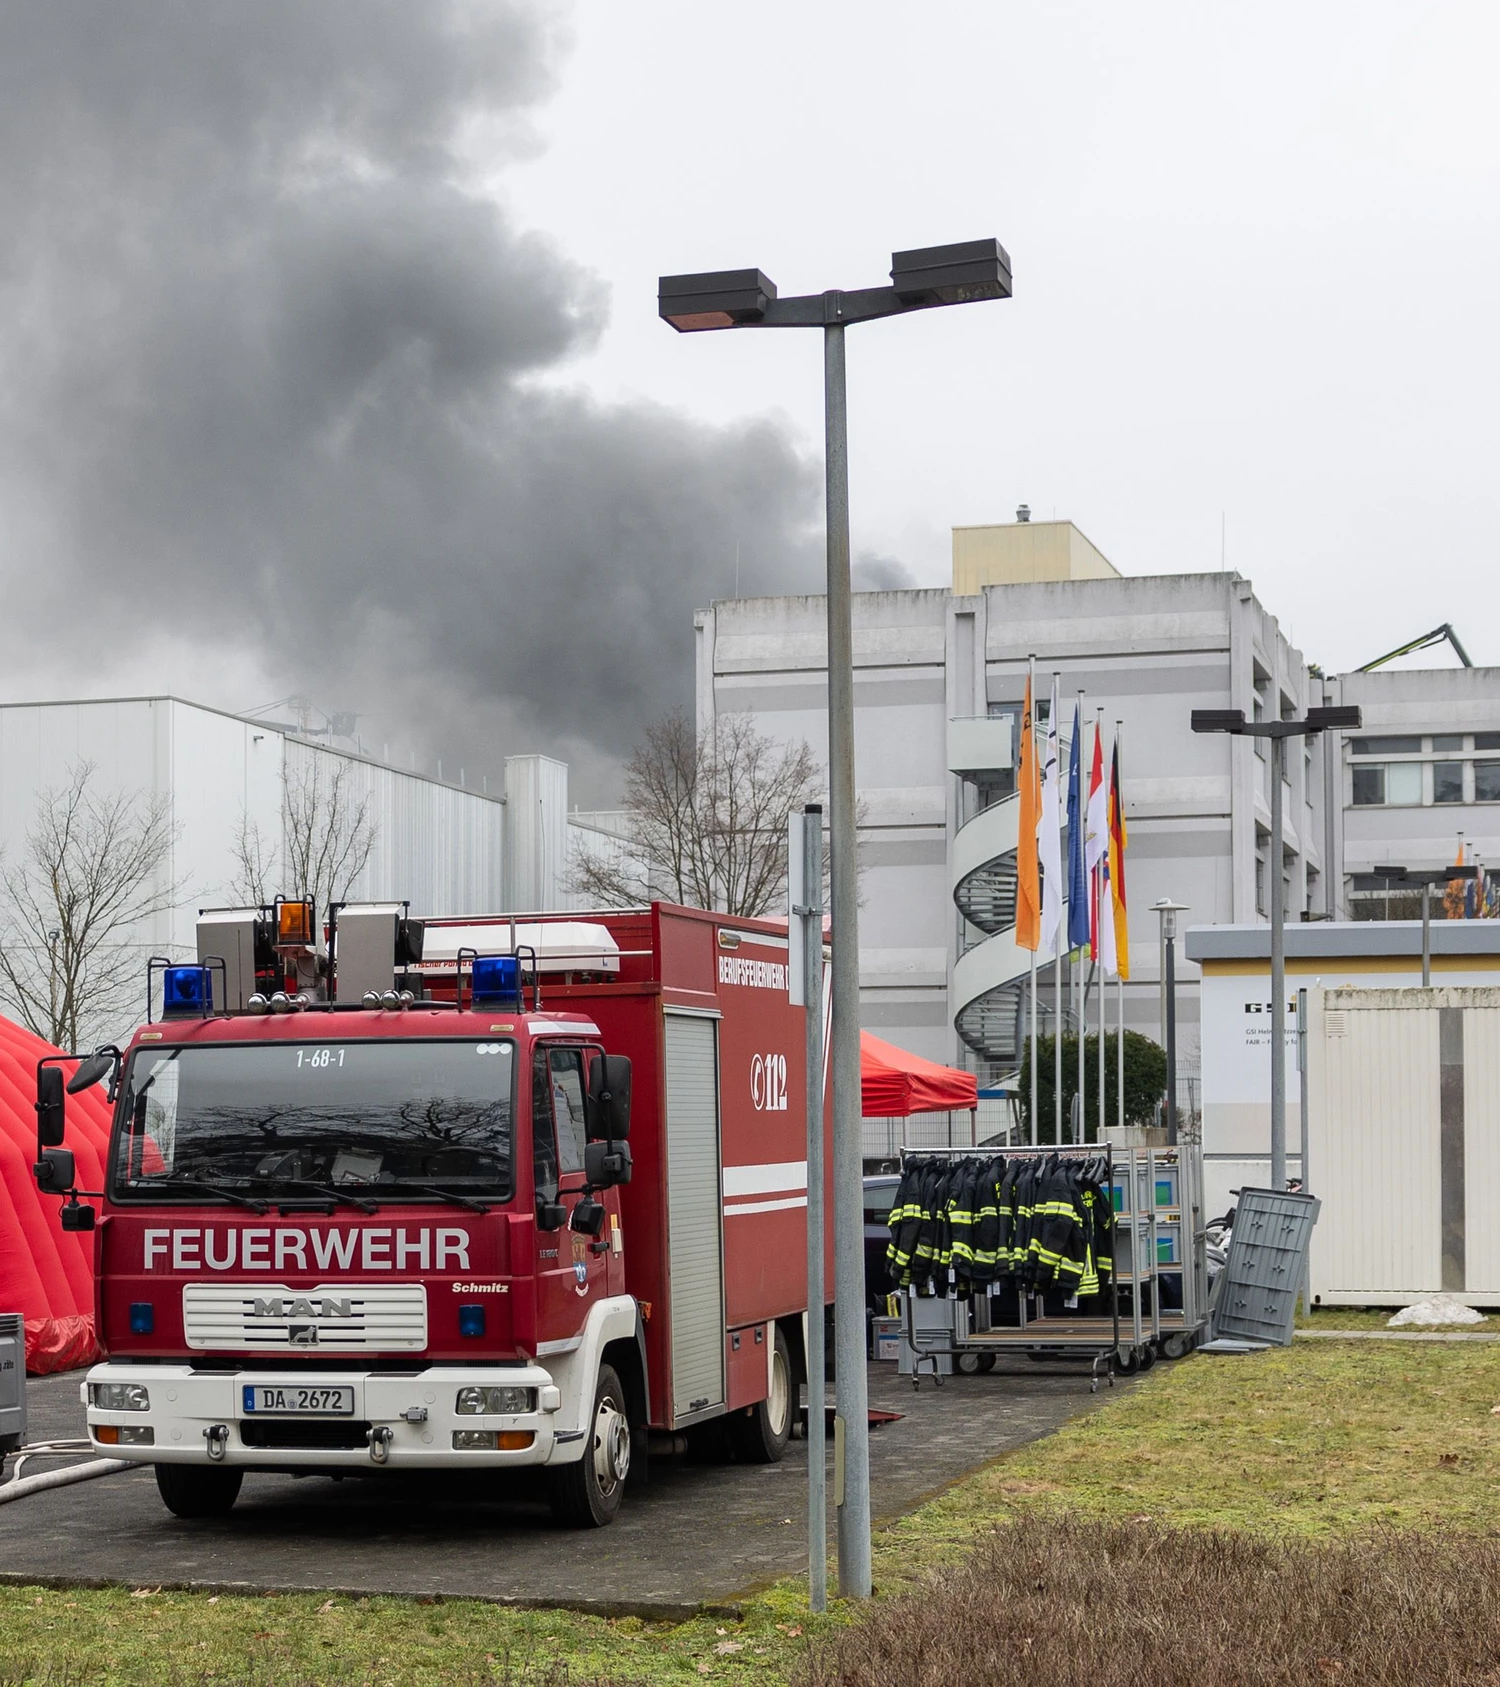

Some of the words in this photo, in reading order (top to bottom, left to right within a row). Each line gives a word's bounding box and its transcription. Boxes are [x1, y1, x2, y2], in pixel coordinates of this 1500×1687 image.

[718, 955, 785, 990] BERUFSFEUERWEHR
[296, 1049, 345, 1067] 1-68-1
[764, 1054, 787, 1110] 112
[143, 1228, 471, 1270] FEUERWEHR
[452, 1281, 509, 1293] Schmitz
[254, 1297, 351, 1317] MAN
[263, 1390, 286, 1408] DA
[298, 1390, 342, 1409] 2672
